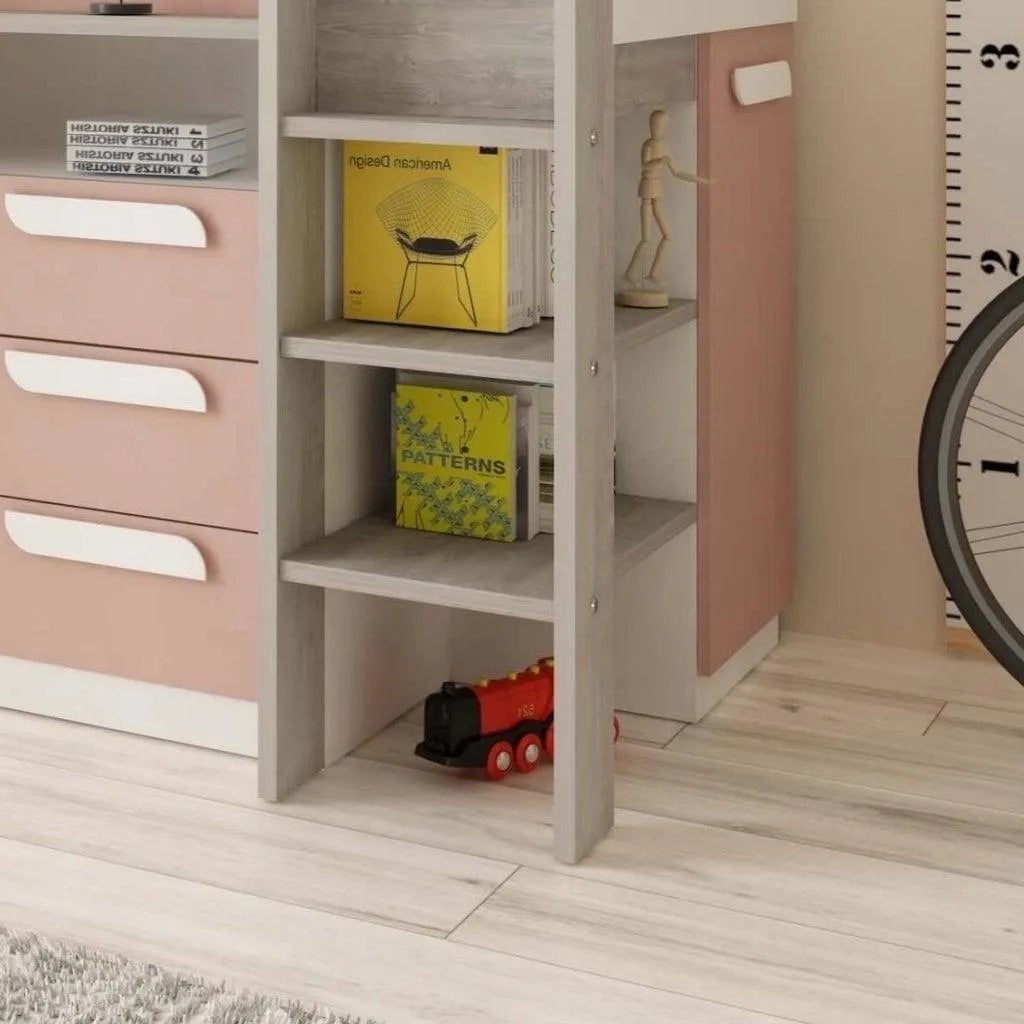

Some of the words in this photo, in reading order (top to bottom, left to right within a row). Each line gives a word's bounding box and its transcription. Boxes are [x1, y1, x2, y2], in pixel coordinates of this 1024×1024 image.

[980, 43, 1020, 70] 3
[980, 249, 1020, 276] 2
[401, 449, 506, 475] PATTERNS
[980, 460, 1020, 477] 1
